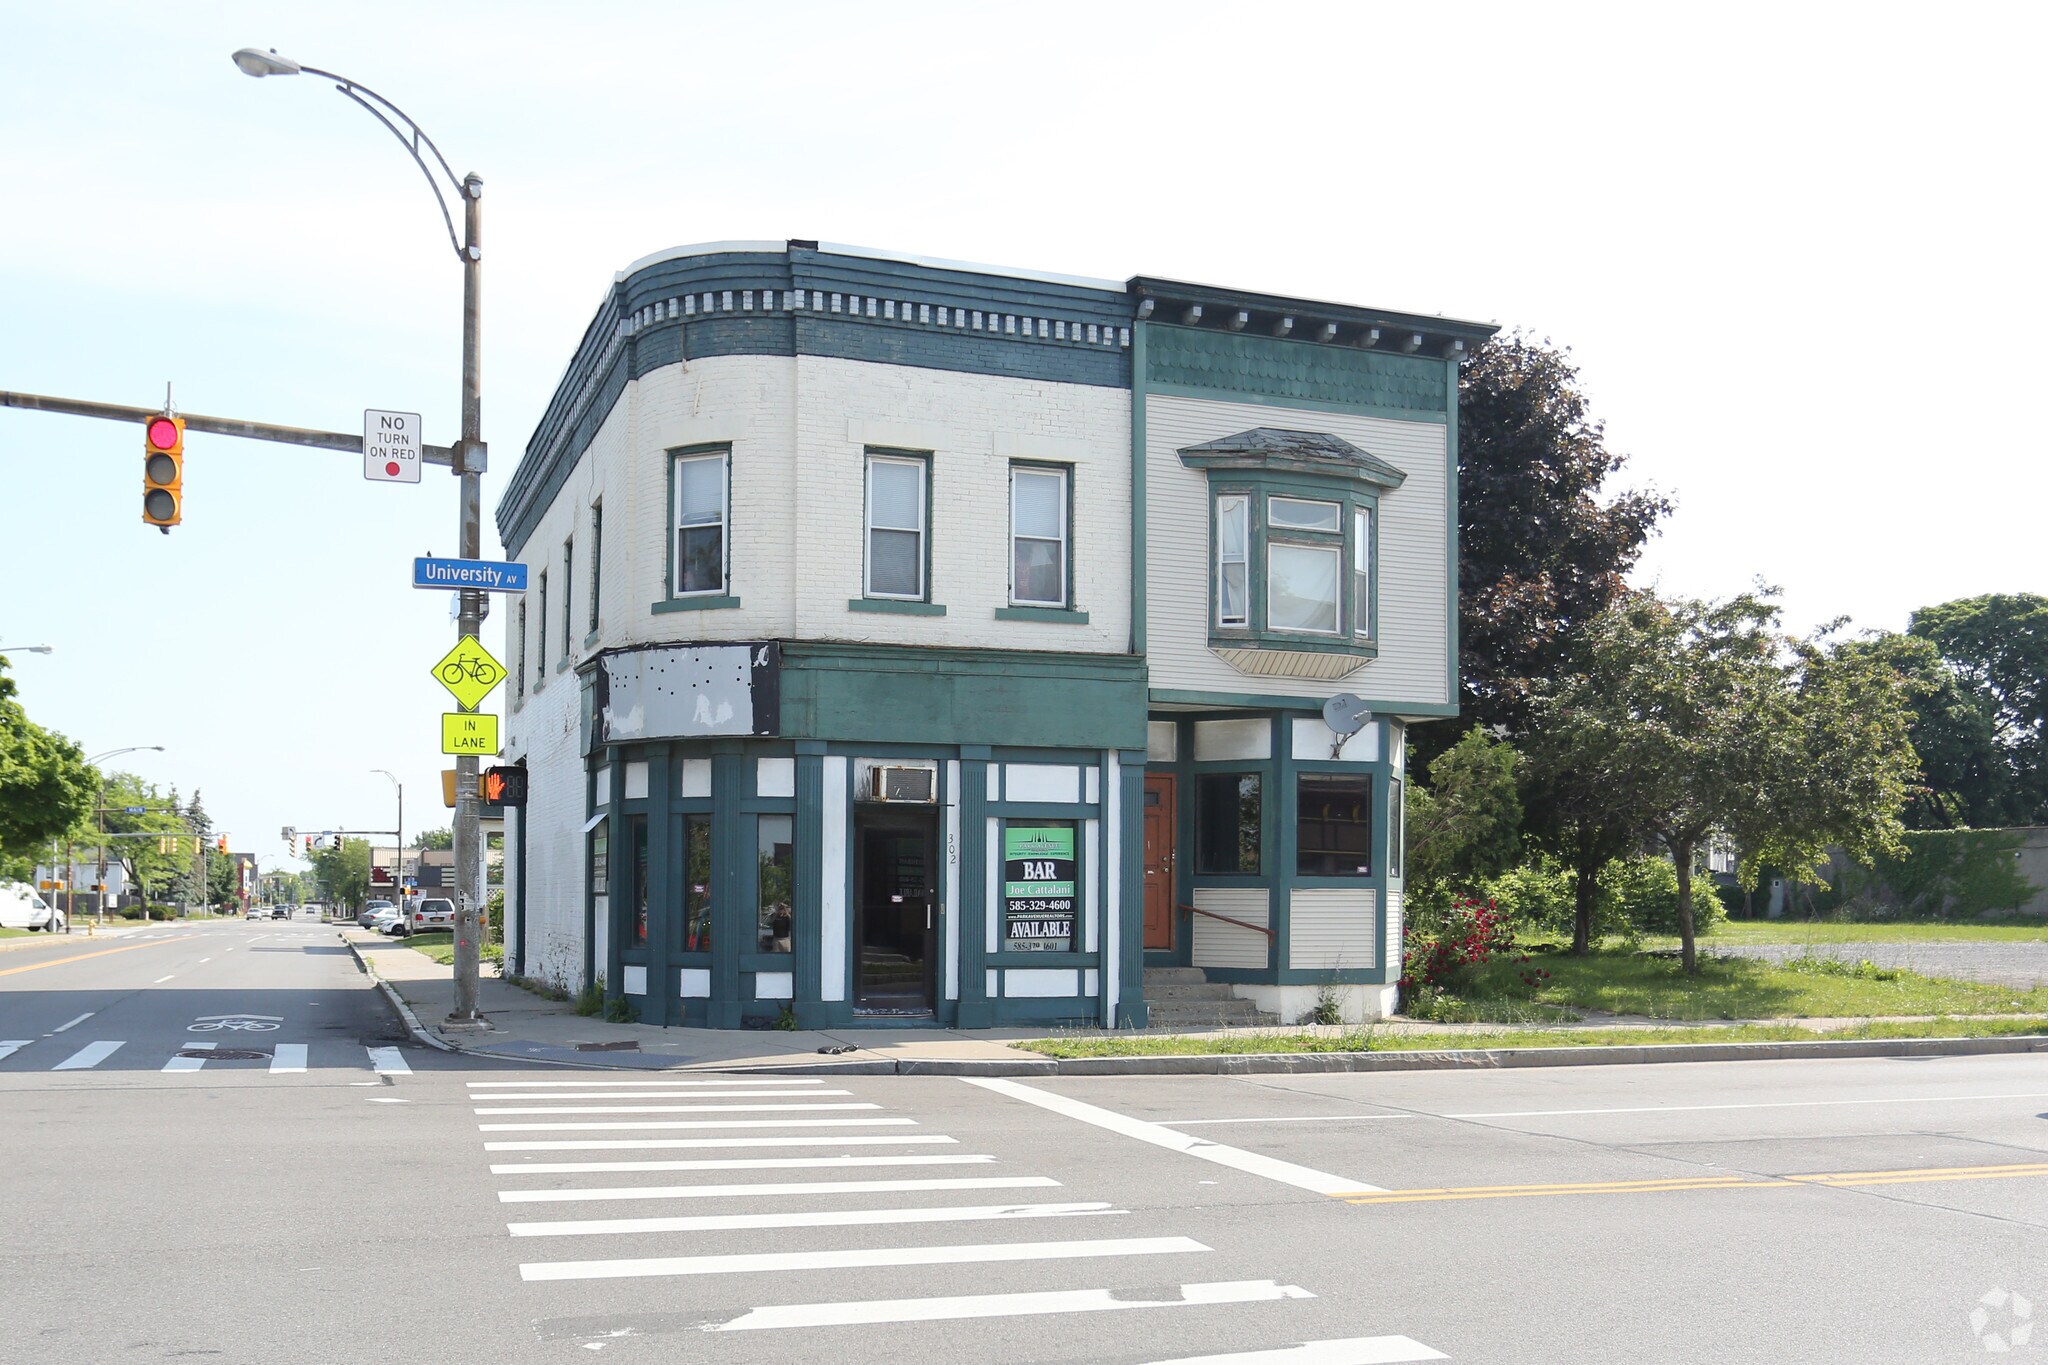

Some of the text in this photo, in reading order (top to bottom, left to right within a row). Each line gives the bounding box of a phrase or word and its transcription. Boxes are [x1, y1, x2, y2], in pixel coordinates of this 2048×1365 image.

[381, 416, 405, 430] NO
[377, 432, 409, 445] TURN
[370, 446, 416, 460] ON RED
[426, 563, 517, 587] University AV
[464, 720, 476, 731] IN
[454, 737, 486, 748] LANE
[948, 833, 957, 864] 302
[1023, 861, 1057, 880] BAR
[1010, 884, 1070, 895] Joe Cattalani
[1009, 900, 1071, 911] 585-329-4600
[1010, 921, 1071, 938] AVAILABLE
